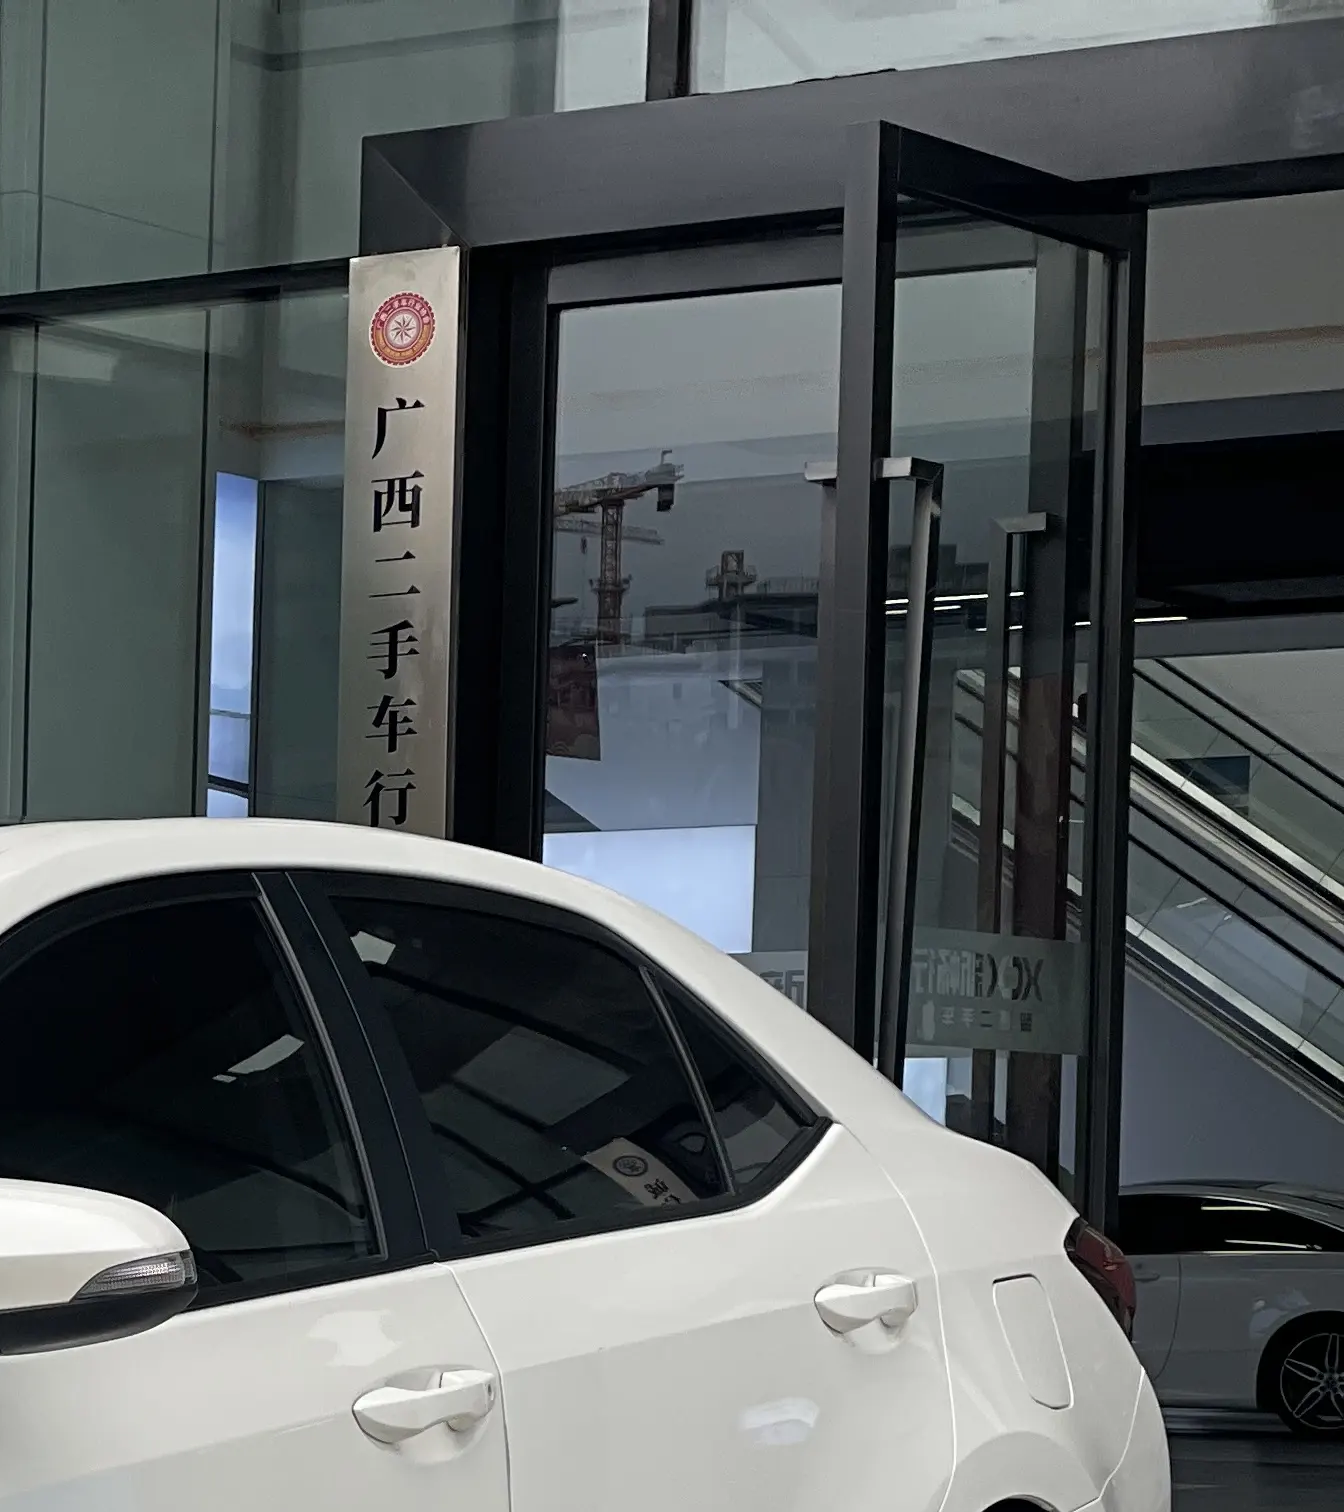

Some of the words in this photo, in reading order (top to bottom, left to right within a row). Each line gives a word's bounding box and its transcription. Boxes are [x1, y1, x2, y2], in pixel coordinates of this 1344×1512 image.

[363, 397, 425, 827] 广西二手车行
